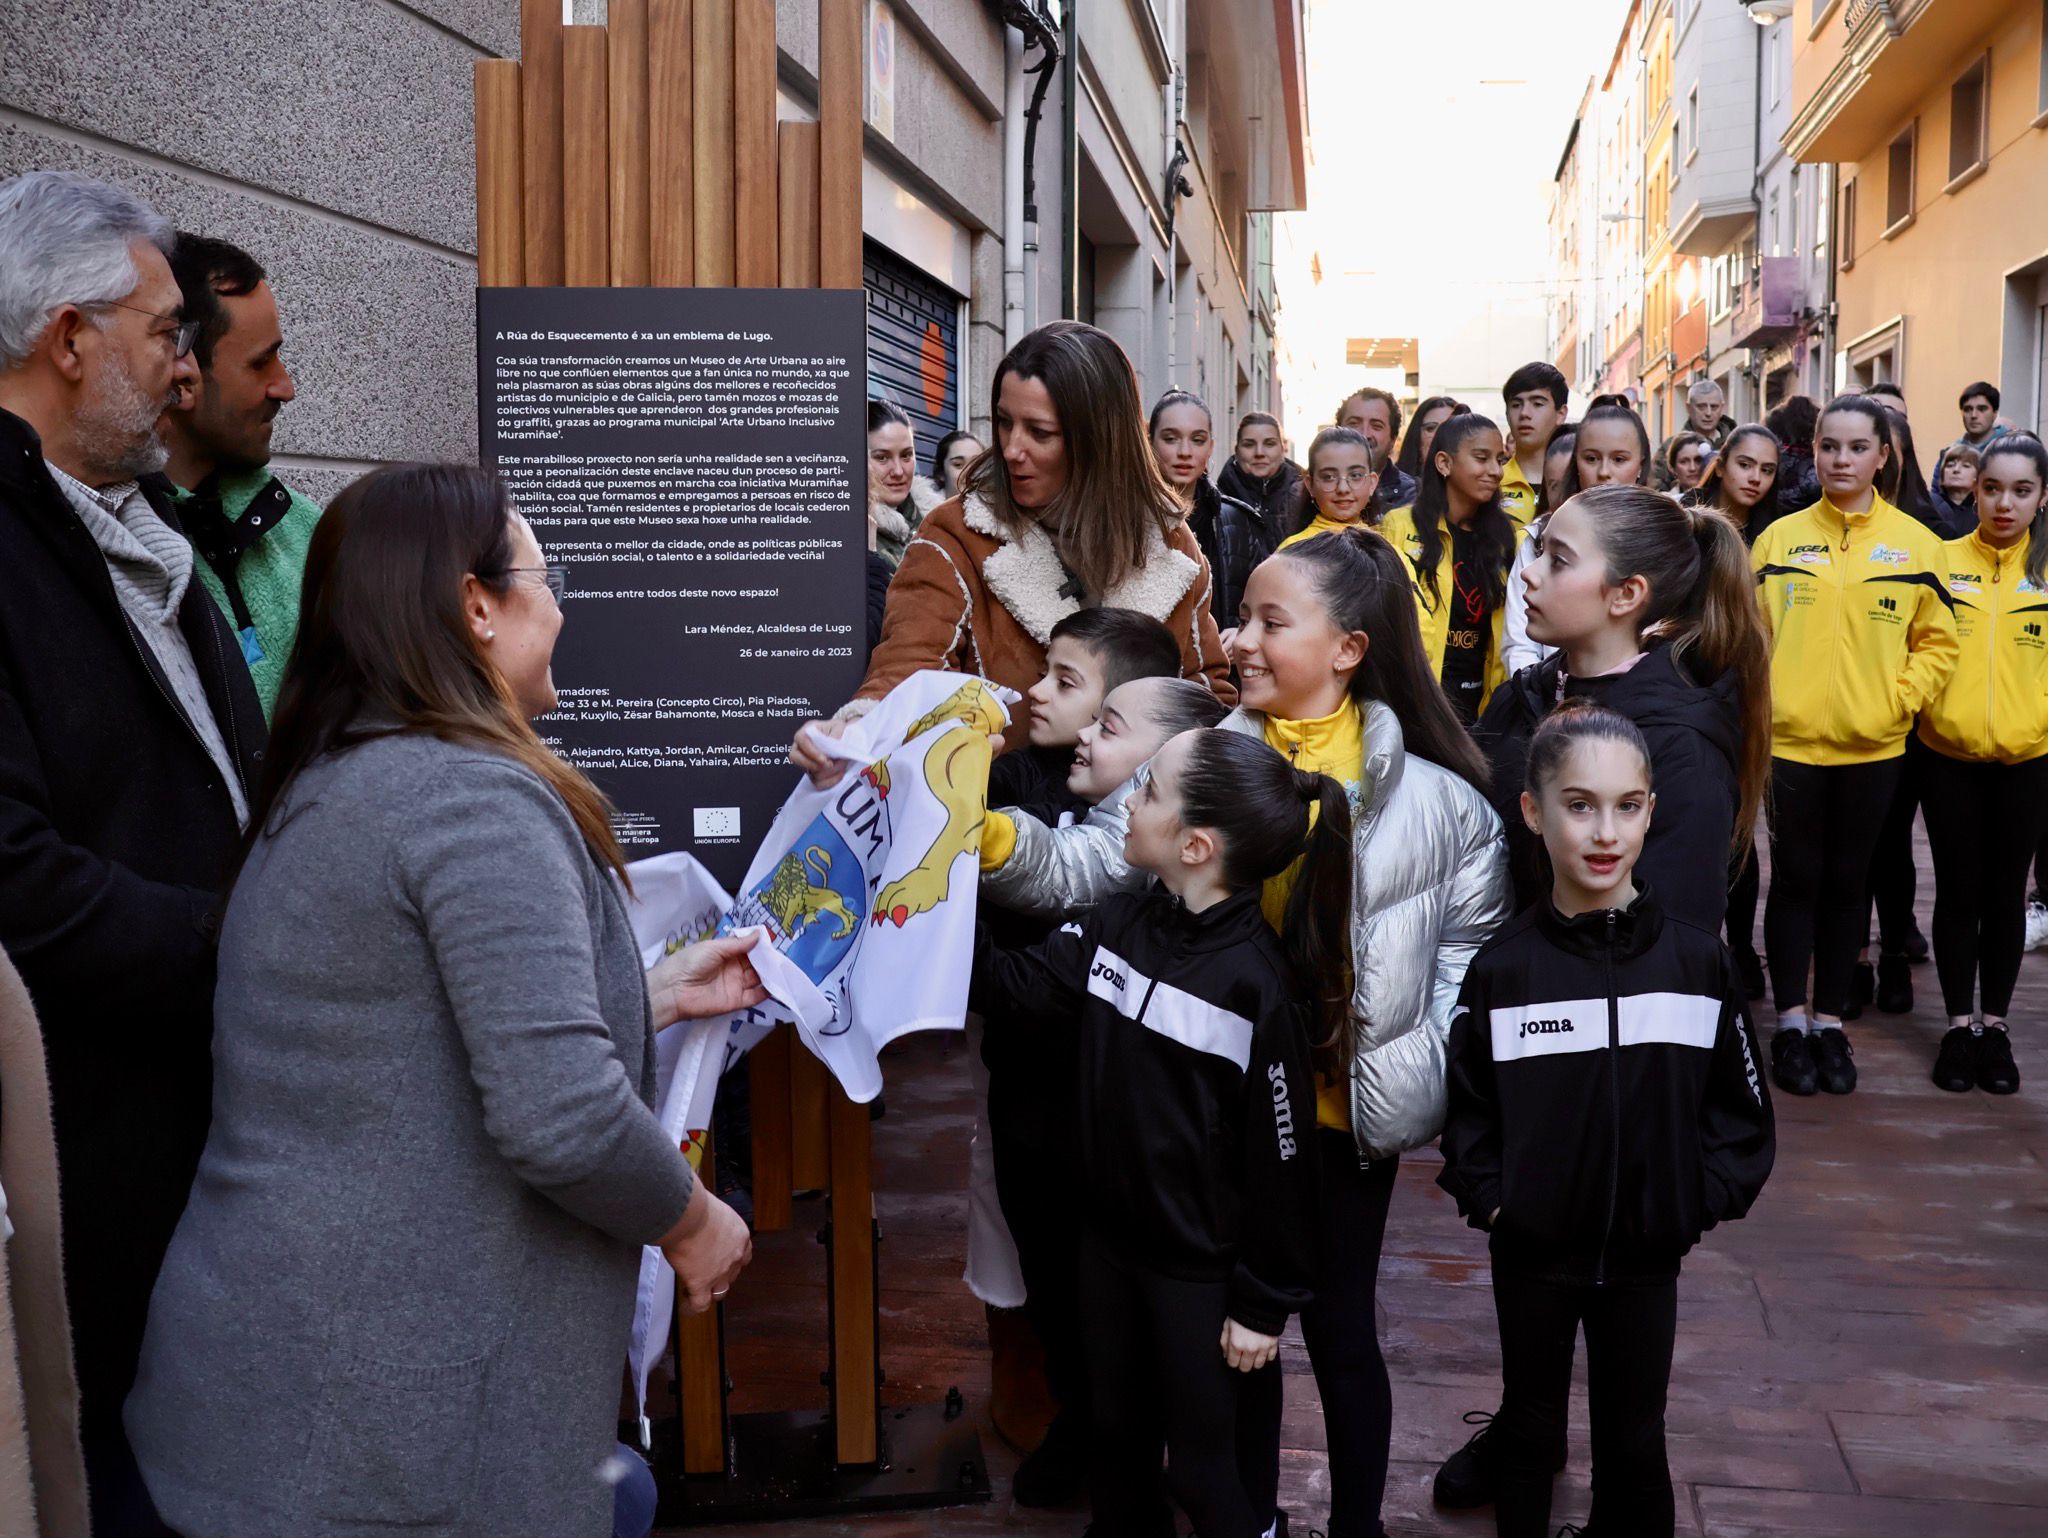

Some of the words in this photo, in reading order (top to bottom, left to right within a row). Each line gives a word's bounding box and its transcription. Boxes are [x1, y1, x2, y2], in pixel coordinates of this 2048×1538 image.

[507, 331, 528, 340] Rúa
[548, 332, 629, 342] Esquecemento
[673, 331, 724, 340] emblema
[744, 332, 773, 342] Lugo.
[496, 356, 516, 365] Coa
[519, 356, 538, 365] súa
[540, 356, 622, 364] transformación
[690, 356, 725, 364] Museo
[744, 356, 766, 365] Arte
[770, 356, 808, 365] Urbana
[826, 356, 846, 366] aire
[497, 368, 520, 378] libre
[563, 368, 610, 377] conflúen
[612, 368, 669, 377] elementos
[703, 368, 720, 376] fan
[724, 368, 752, 377] única
[772, 368, 812, 379] mundo,
[497, 381, 519, 390] nela
[522, 380, 578, 391] plasmaron
[596, 380, 620, 390] súas
[622, 380, 652, 390] obras
[655, 380, 691, 391] algúns
[693, 380, 712, 389] dos
[715, 380, 760, 390] mellores
[772, 378, 836, 390] recoñecidos
[497, 393, 536, 402] artistas
[556, 392, 609, 404] municipio
[637, 392, 675, 403] Galicia,
[678, 394, 702, 404] pero
[704, 392, 739, 402] tamén
[497, 405, 550, 414] colectivos
[553, 405, 614, 414] vulnerables
[640, 405, 702, 416] aprenderon
[708, 405, 727, 414] dos
[730, 405, 773, 416] grandes
[776, 404, 840, 416] profesionais
[514, 418, 552, 428] graffiti,
[556, 420, 590, 428] grazas
[609, 419, 661, 428] programa
[664, 417, 716, 428] municipal
[719, 416, 744, 426] 'Arte
[747, 416, 786, 426] Urbano
[789, 417, 835, 426] Inclusivo
[498, 428, 563, 439] Muramiñae'.
[498, 456, 520, 464] Este
[523, 454, 584, 464] marabilloso
[587, 456, 632, 465] proxecto
[658, 454, 682, 463] sería
[685, 454, 712, 462] unha
[715, 454, 763, 462] realidade
[794, 454, 848, 464] veciñanza,
[546, 466, 618, 478] peonalización
[622, 466, 651, 476] deste
[653, 466, 694, 475] enclave
[732, 466, 752, 476] dun
[756, 468, 797, 478] proceso
[816, 466, 844, 478] parti-
[546, 477, 581, 488] cidadá
[608, 480, 656, 490] puxemos
[676, 478, 715, 488] marcha
[740, 478, 786, 487] iniciativa
[790, 478, 849, 487] Muramiñae
[602, 491, 656, 500] formamos
[668, 492, 739, 502] empregamos
[751, 492, 791, 501] persoas
[810, 490, 834, 499] risco
[551, 504, 584, 512] social.
[586, 504, 622, 512] Tamén
[626, 503, 681, 512] residentes
[693, 502, 756, 514] propietarios
[775, 502, 804, 512] locais
[807, 502, 850, 511] cederon
[564, 518, 587, 526] para
[614, 516, 636, 524] este
[639, 516, 674, 524] Museo
[702, 515, 728, 524] hoxe
[730, 515, 757, 524] unha
[760, 514, 811, 524] realidade.
[546, 542, 602, 552] representa
[615, 540, 649, 549] mellor
[668, 540, 706, 550] cidade,
[708, 540, 735, 548] onde
[752, 538, 796, 550] políticas
[799, 538, 842, 550] públicas
[1788, 544, 1830, 556] LEGEA
[562, 552, 609, 562] inclusión
[612, 552, 644, 562] social,
[656, 552, 694, 561] talento
[714, 551, 785, 560] solidariedade
[788, 550, 824, 560] veciñal
[1949, 573, 1982, 584] EGEA
[616, 590, 644, 598] entre
[647, 588, 677, 598] todos
[679, 588, 708, 598] deste
[740, 588, 778, 598] espazo!
[685, 625, 707, 634] Lara
[710, 624, 754, 634] Méndez,
[756, 624, 806, 632] Alcaldesa
[826, 624, 852, 634] Lugo
[740, 648, 752, 658] 26
[771, 648, 810, 656] xaneiro
[828, 648, 852, 656] 2023
[556, 700, 575, 708] Yoe
[578, 700, 590, 708] 33
[616, 698, 653, 708] Pereira
[656, 697, 710, 708] (Concepto
[712, 696, 745, 708] Circo),
[748, 696, 764, 706] Pia
[767, 696, 810, 706] Piadosa,
[542, 712, 578, 722] Núñez,
[581, 710, 621, 722] Kuxyllo,
[624, 710, 652, 720] Zësar
[655, 708, 719, 720] Bahamonte,
[722, 708, 754, 718] Mosca
[767, 708, 794, 717] Nada
[797, 707, 822, 716] Bien.
[571, 746, 624, 758] Alejandro,
[627, 746, 662, 758] Kattya,
[665, 746, 704, 756] Jordan,
[706, 744, 749, 755] Amilcar,
[576, 760, 618, 769] Manuel,
[620, 756, 651, 768] ALice,
[654, 755, 686, 768] Diana,
[689, 755, 730, 768] Yahaira,
[732, 756, 772, 766] Alberto
[632, 836, 660, 844] Europa
[1268, 1062, 1297, 1160] Joma
